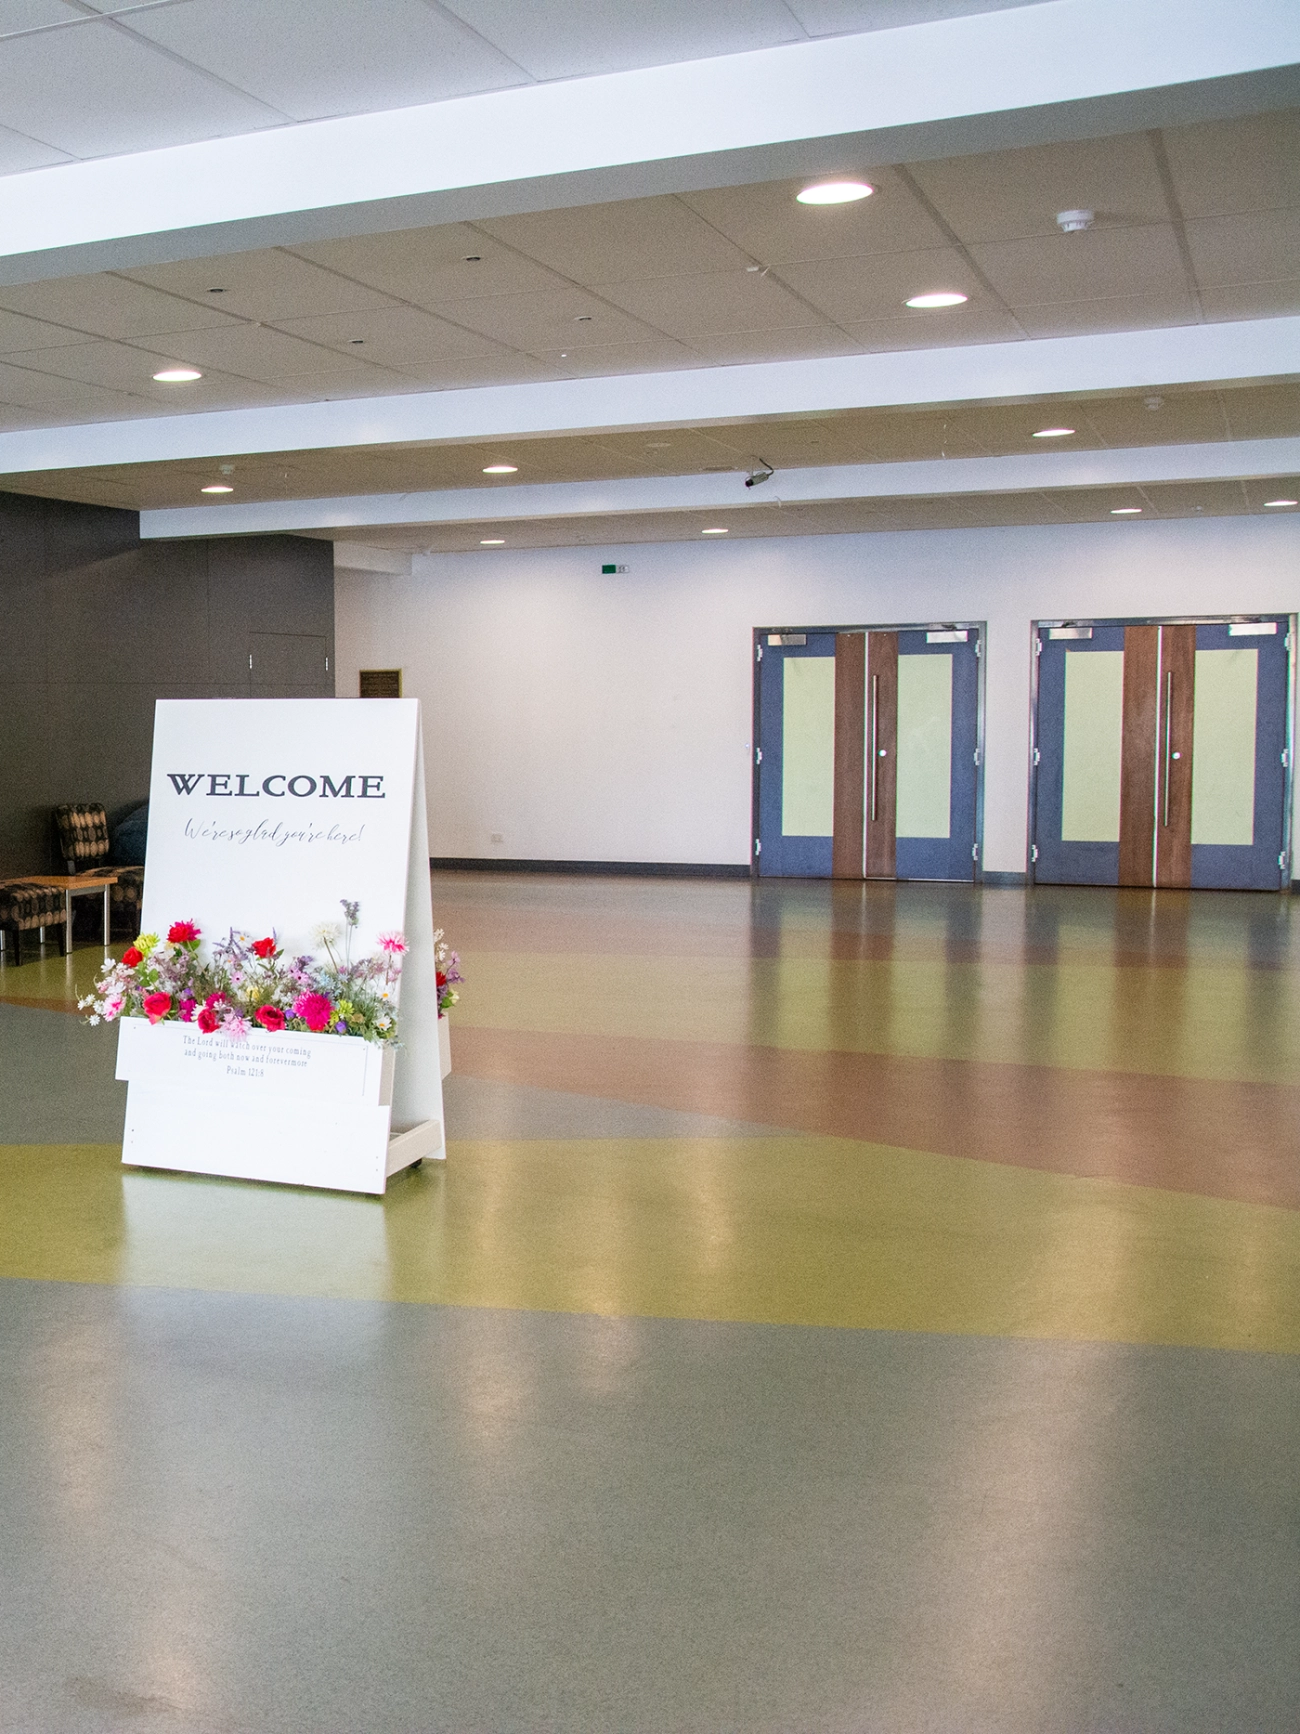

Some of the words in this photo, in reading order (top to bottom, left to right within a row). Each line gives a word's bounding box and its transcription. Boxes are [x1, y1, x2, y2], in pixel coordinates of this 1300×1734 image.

[167, 773, 386, 799] WELCOME
[184, 817, 228, 841] We're
[228, 829, 243, 841] so
[238, 819, 284, 844] glad
[275, 822, 326, 847] you're
[327, 823, 366, 844] here!
[183, 1035, 195, 1045] The
[197, 1037, 213, 1047] Lord
[215, 1039, 229, 1048] will
[230, 1041, 250, 1050] watch
[268, 1046, 284, 1057] your
[286, 1048, 312, 1059] coming
[184, 1048, 197, 1057] and
[198, 1051, 217, 1061] going
[219, 1050, 235, 1060] both
[236, 1054, 249, 1062] now
[251, 1055, 264, 1063] and
[266, 1056, 308, 1067] forevermore
[226, 1065, 246, 1076] Psalm
[248, 1068, 265, 1077] 121:8
